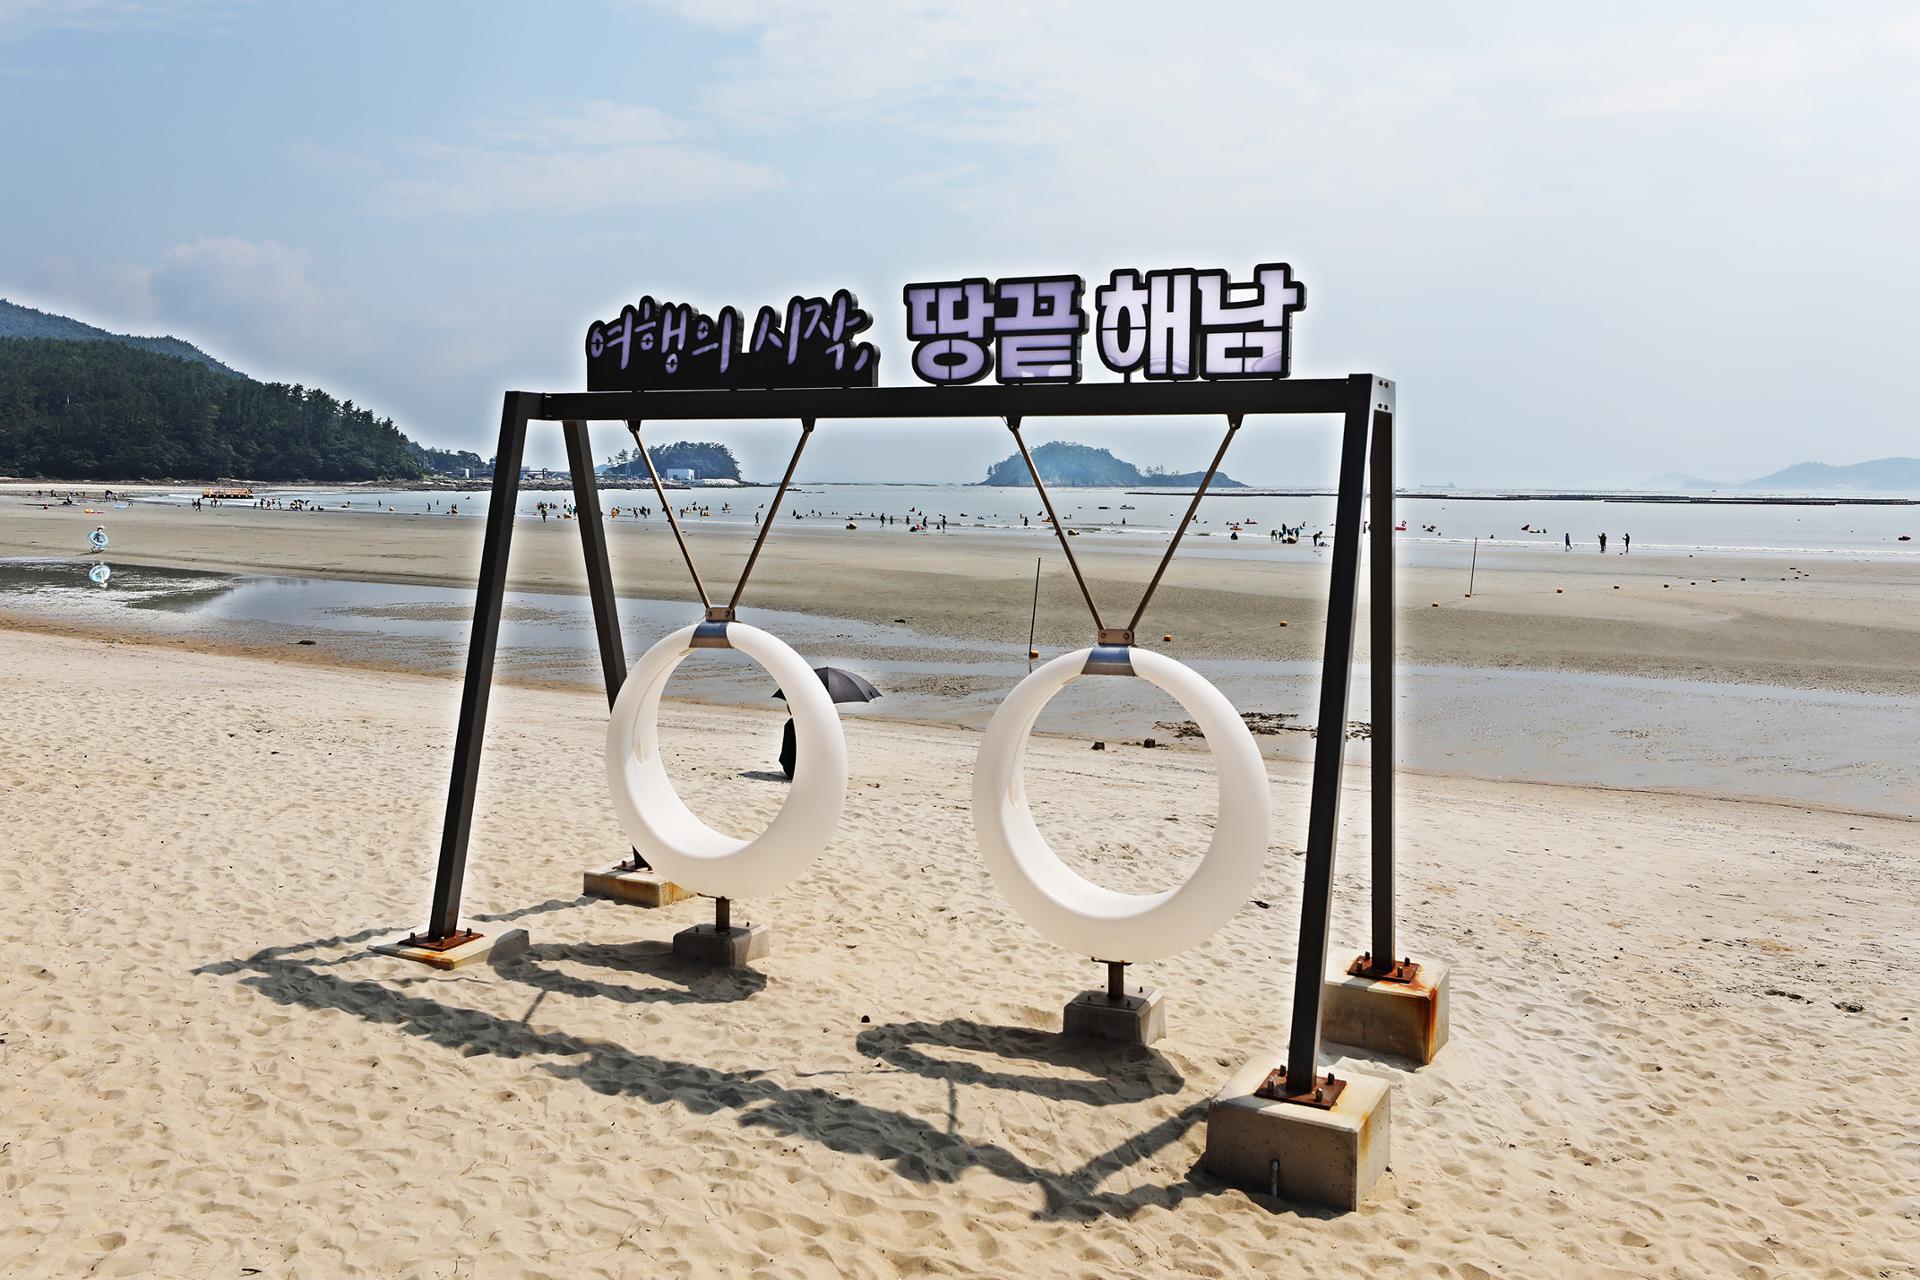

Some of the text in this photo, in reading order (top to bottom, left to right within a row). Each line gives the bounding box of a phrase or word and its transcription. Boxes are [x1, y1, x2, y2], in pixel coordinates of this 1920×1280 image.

[589, 300, 730, 375] 여행의
[905, 275, 1084, 384] 땅끝
[1098, 265, 1301, 378] 해남
